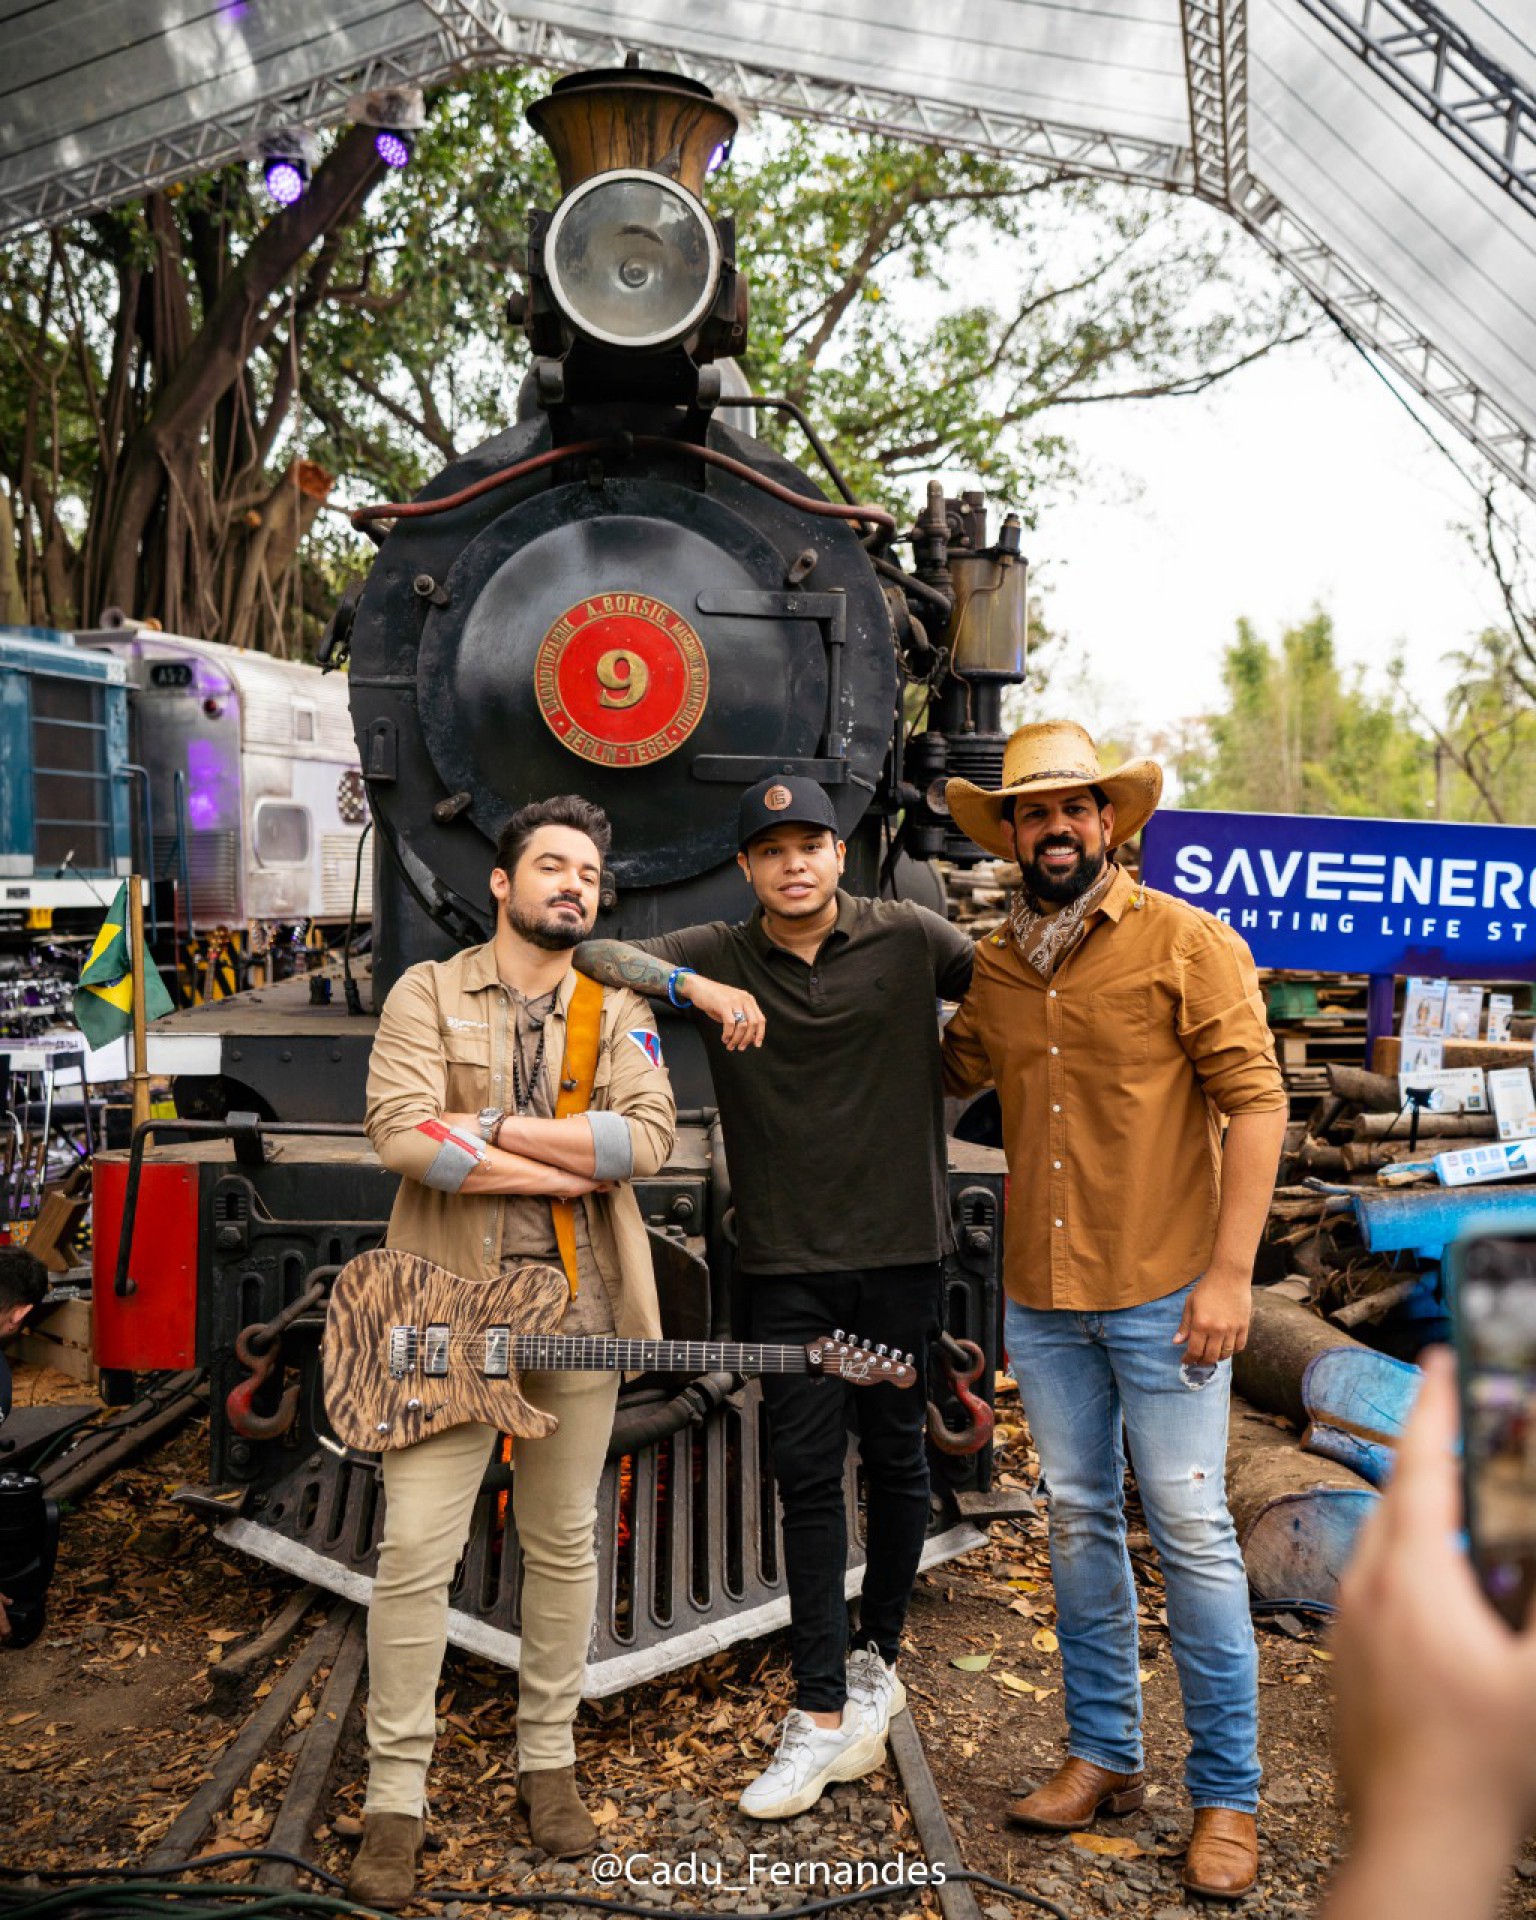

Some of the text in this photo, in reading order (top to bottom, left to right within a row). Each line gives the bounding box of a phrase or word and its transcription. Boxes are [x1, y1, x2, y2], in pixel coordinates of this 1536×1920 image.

[597, 650, 648, 708] 9
[1201, 906, 1528, 942] GHTING LIFE ST
